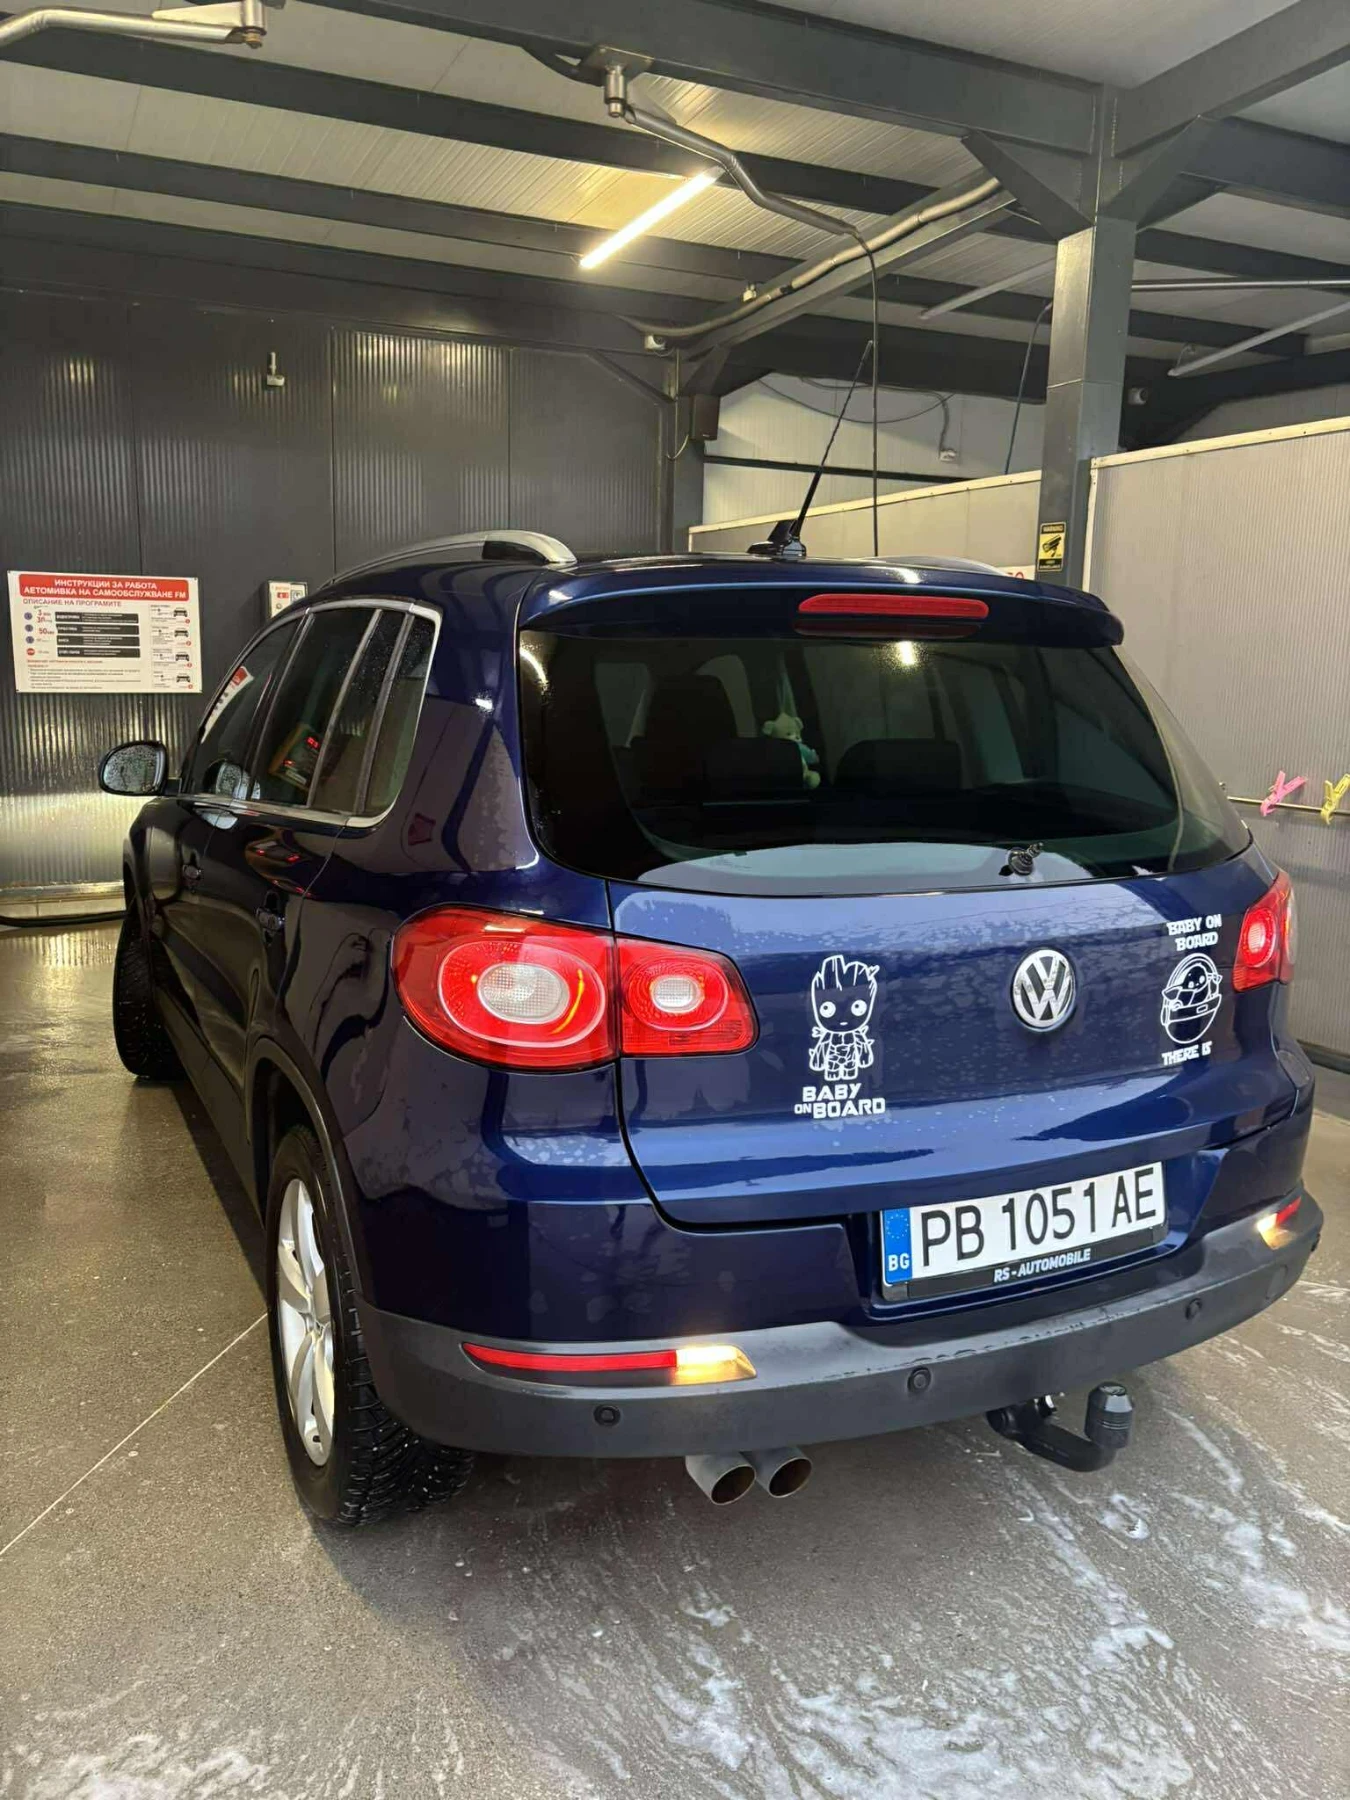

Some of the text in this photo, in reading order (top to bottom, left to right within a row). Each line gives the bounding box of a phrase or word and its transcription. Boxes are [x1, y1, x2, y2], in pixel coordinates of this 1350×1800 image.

[54, 579, 157, 590] ИНСТРУКЦИИ ЗА РАБОТА
[78, 588, 91, 596] НА
[92, 588, 173, 598] САМООБСЛУЖВАНЕ
[174, 591, 187, 599] FM
[22, 598, 63, 606] ОПИСАНИЕ
[76, 600, 122, 608] ПРОГРАМИТЕ
[1166, 914, 1222, 936] BABY ON
[1175, 931, 1218, 951] BOARD
[1014, 951, 1073, 1027] VW
[1161, 1044, 1199, 1066] THERE
[802, 1083, 862, 1102] BABY
[794, 1097, 886, 1119] ON BOARD
[921, 1167, 1156, 1267] PB 1051 AE
[888, 1254, 910, 1272] BG
